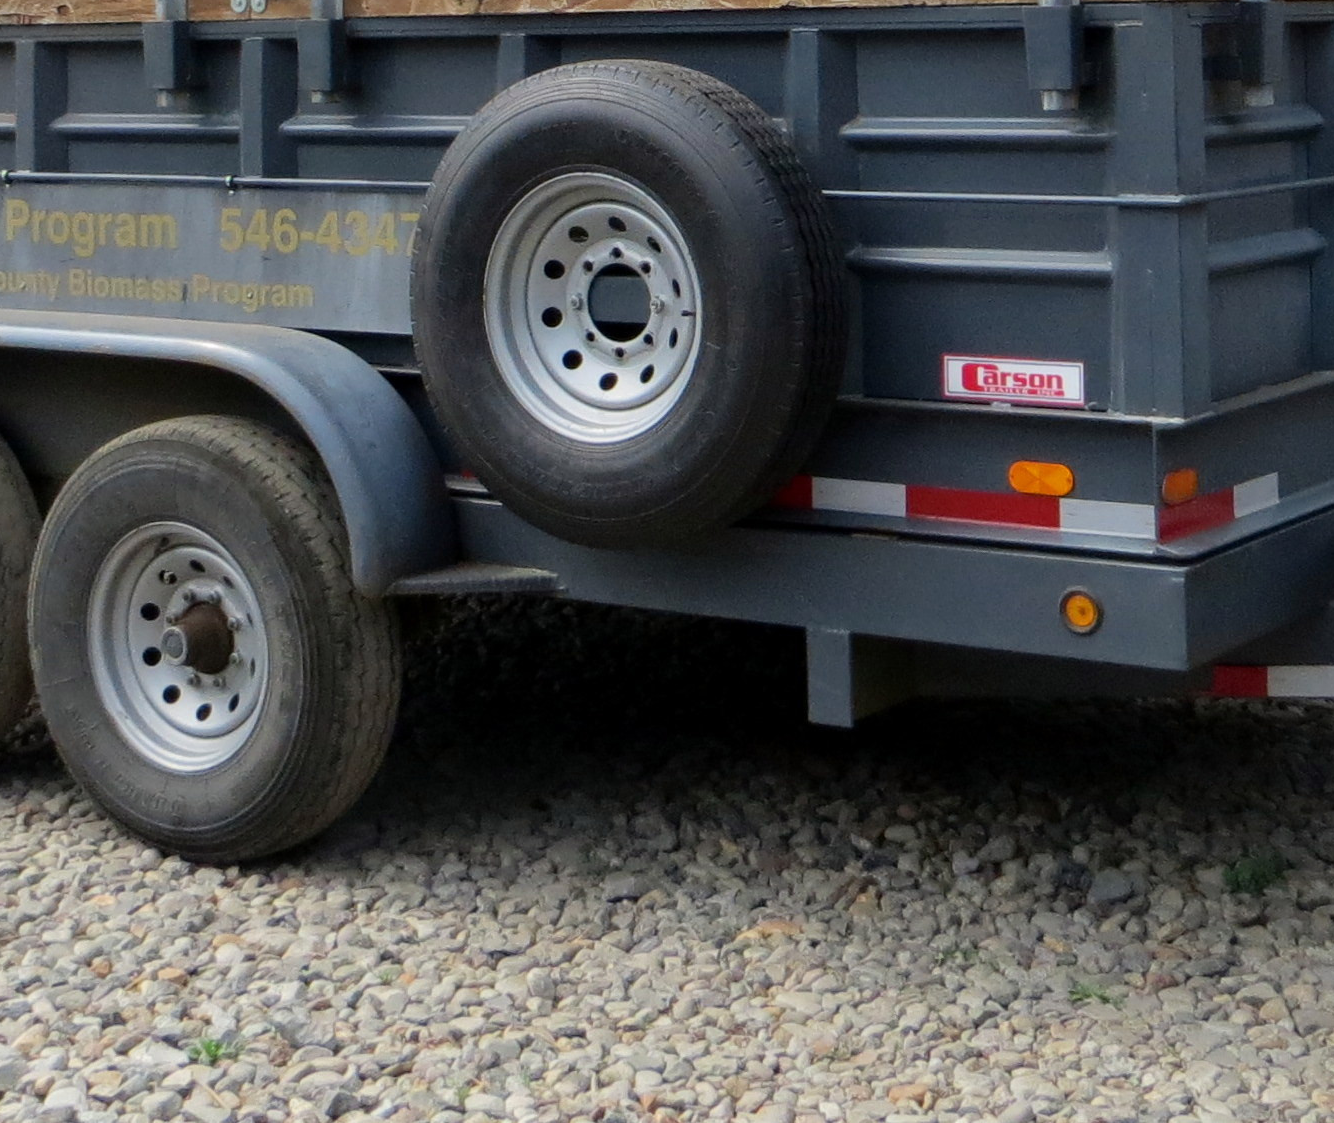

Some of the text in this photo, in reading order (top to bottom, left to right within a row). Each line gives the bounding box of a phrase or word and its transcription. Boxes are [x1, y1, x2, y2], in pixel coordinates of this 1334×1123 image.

[5, 198, 179, 258] Program
[218, 207, 420, 258] 546-4347
[70, 269, 183, 302] Biomass
[192, 273, 314, 313] Program
[962, 363, 1063, 392] Carson
